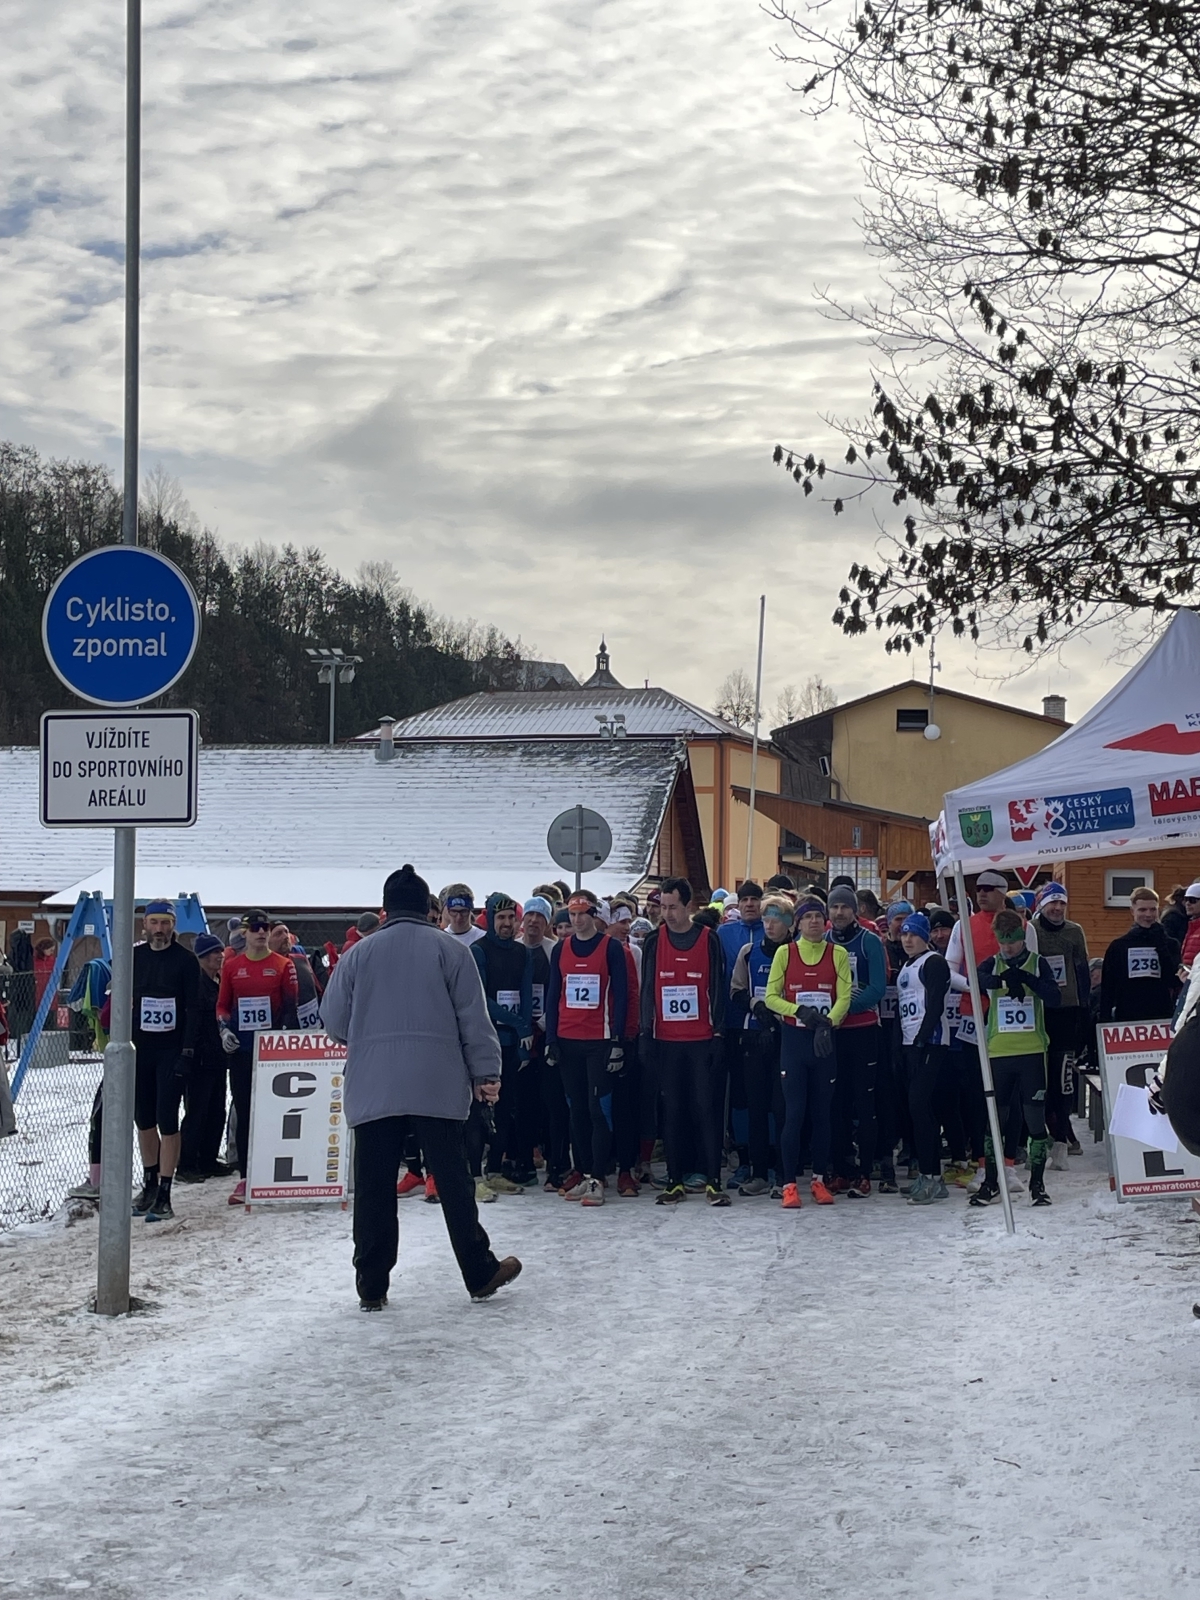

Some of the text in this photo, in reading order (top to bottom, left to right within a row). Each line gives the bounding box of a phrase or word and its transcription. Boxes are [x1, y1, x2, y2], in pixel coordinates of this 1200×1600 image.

[66, 597, 176, 628] Cyklisto,
[72, 632, 167, 663] zpomal
[86, 727, 150, 749] VJÍŽDÍTE
[53, 755, 184, 778] DO SPORTOVNÍHO
[88, 786, 147, 807] AREÁLU
[1066, 794, 1102, 809] ČESKÝ
[1068, 801, 1131, 821] ATLETICKÝ
[1070, 819, 1100, 832] SVAZ
[1131, 959, 1159, 971] 238
[574, 988, 590, 1001] 12
[669, 999, 691, 1013] 80
[143, 1010, 174, 1025] 230
[242, 1009, 267, 1023] 318
[1005, 1010, 1027, 1024] 50
[254, 1186, 340, 1198] www.maratonstav.cz
